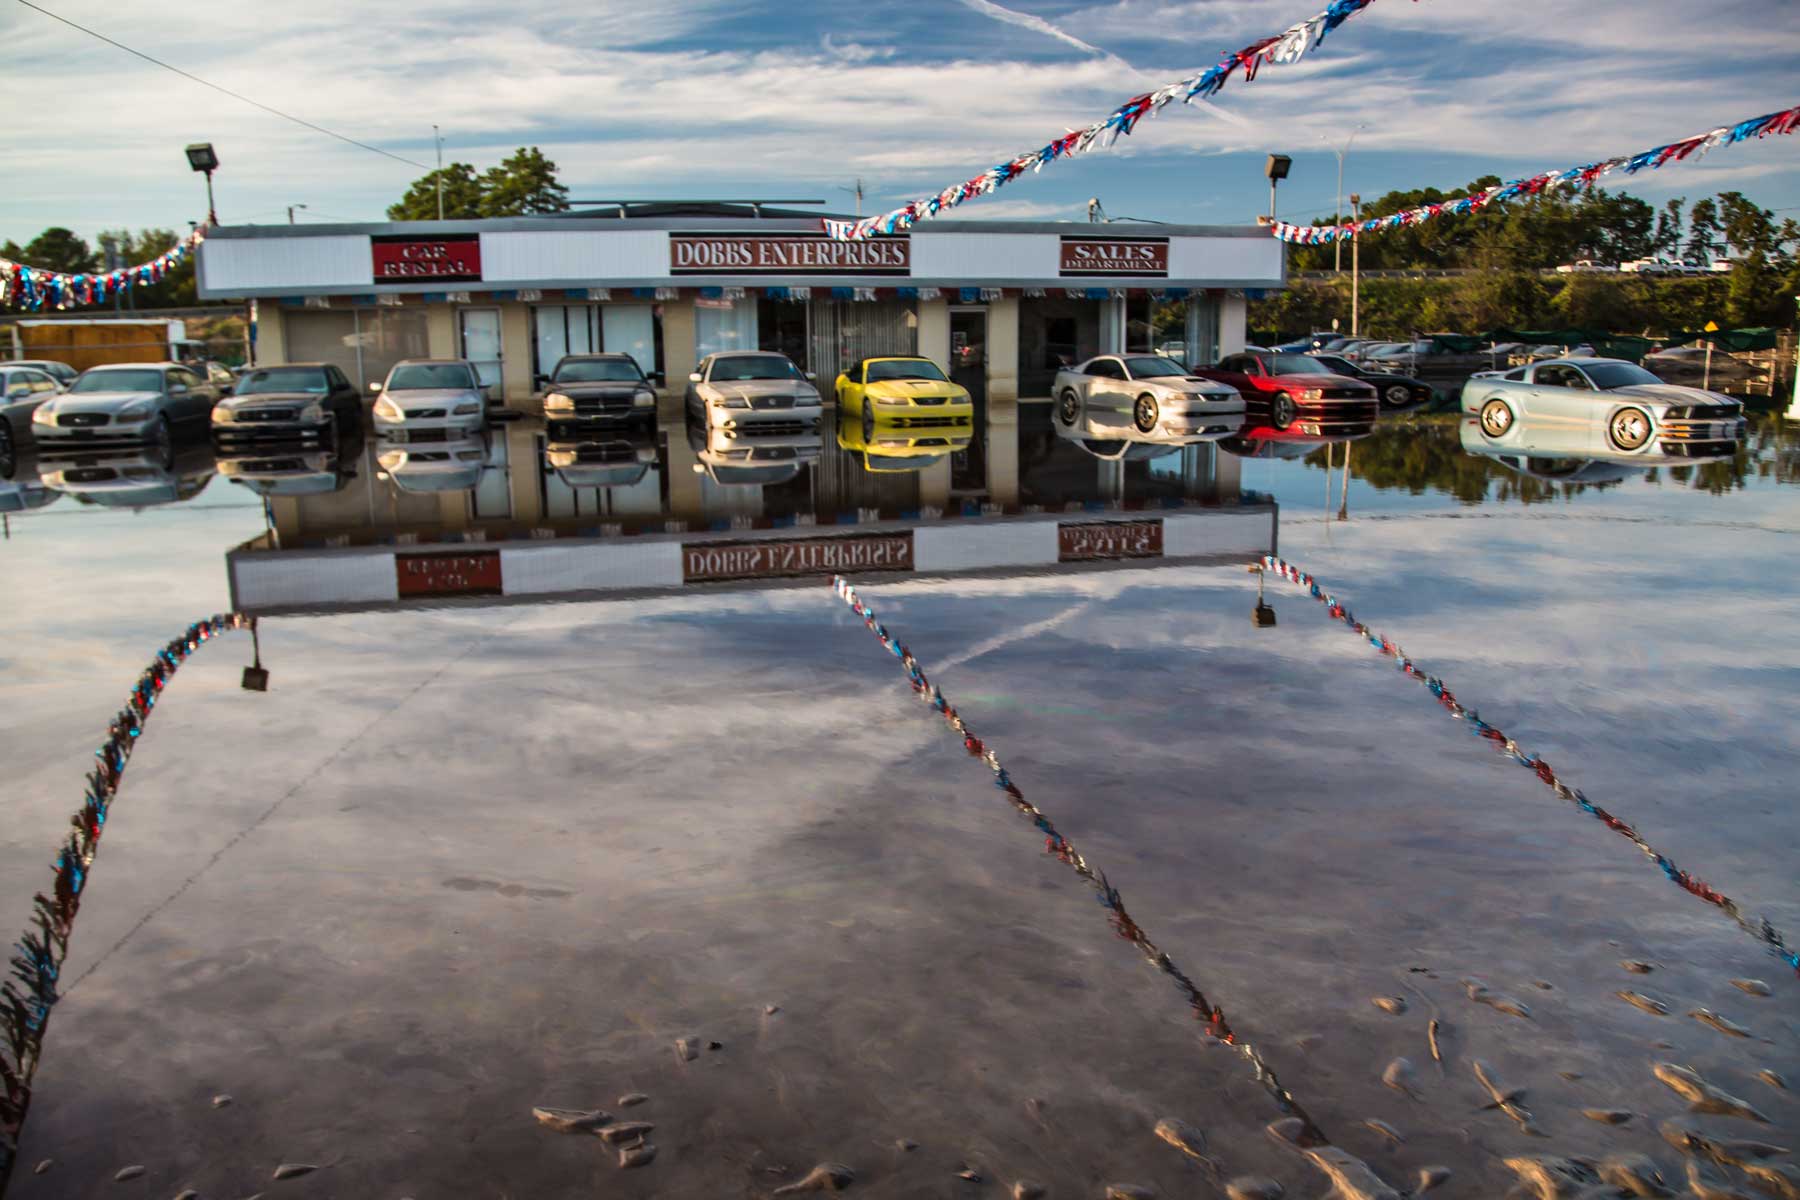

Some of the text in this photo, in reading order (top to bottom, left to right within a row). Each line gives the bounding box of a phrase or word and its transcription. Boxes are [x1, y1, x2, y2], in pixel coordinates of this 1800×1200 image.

[402, 245, 448, 259] CAR
[677, 240, 904, 266] DOBBS ENTERPRISES
[1074, 245, 1155, 260] SALES
[383, 261, 472, 275] RENTAL
[1065, 259, 1164, 269] DEPARTMENT
